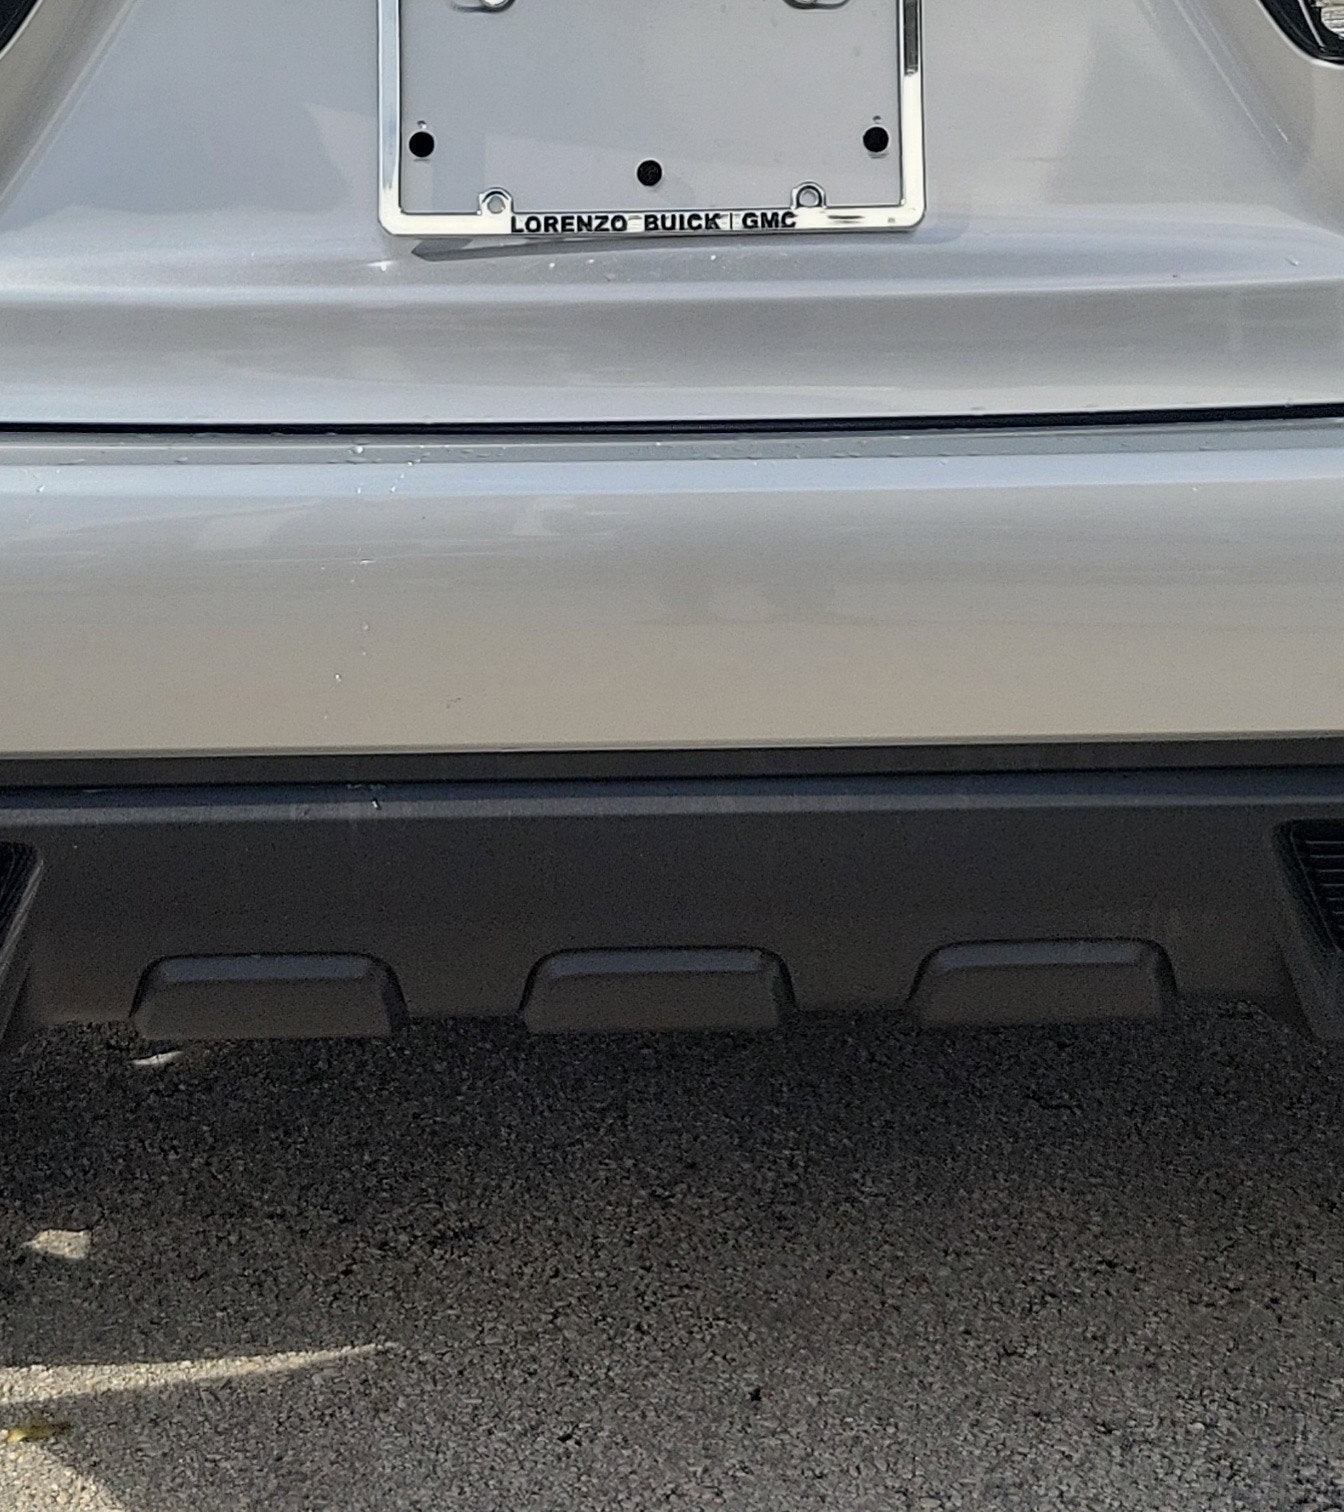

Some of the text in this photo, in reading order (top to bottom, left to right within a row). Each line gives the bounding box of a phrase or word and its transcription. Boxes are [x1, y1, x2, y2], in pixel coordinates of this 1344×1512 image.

[510, 211, 798, 233] LORENZO BUICK GMC
